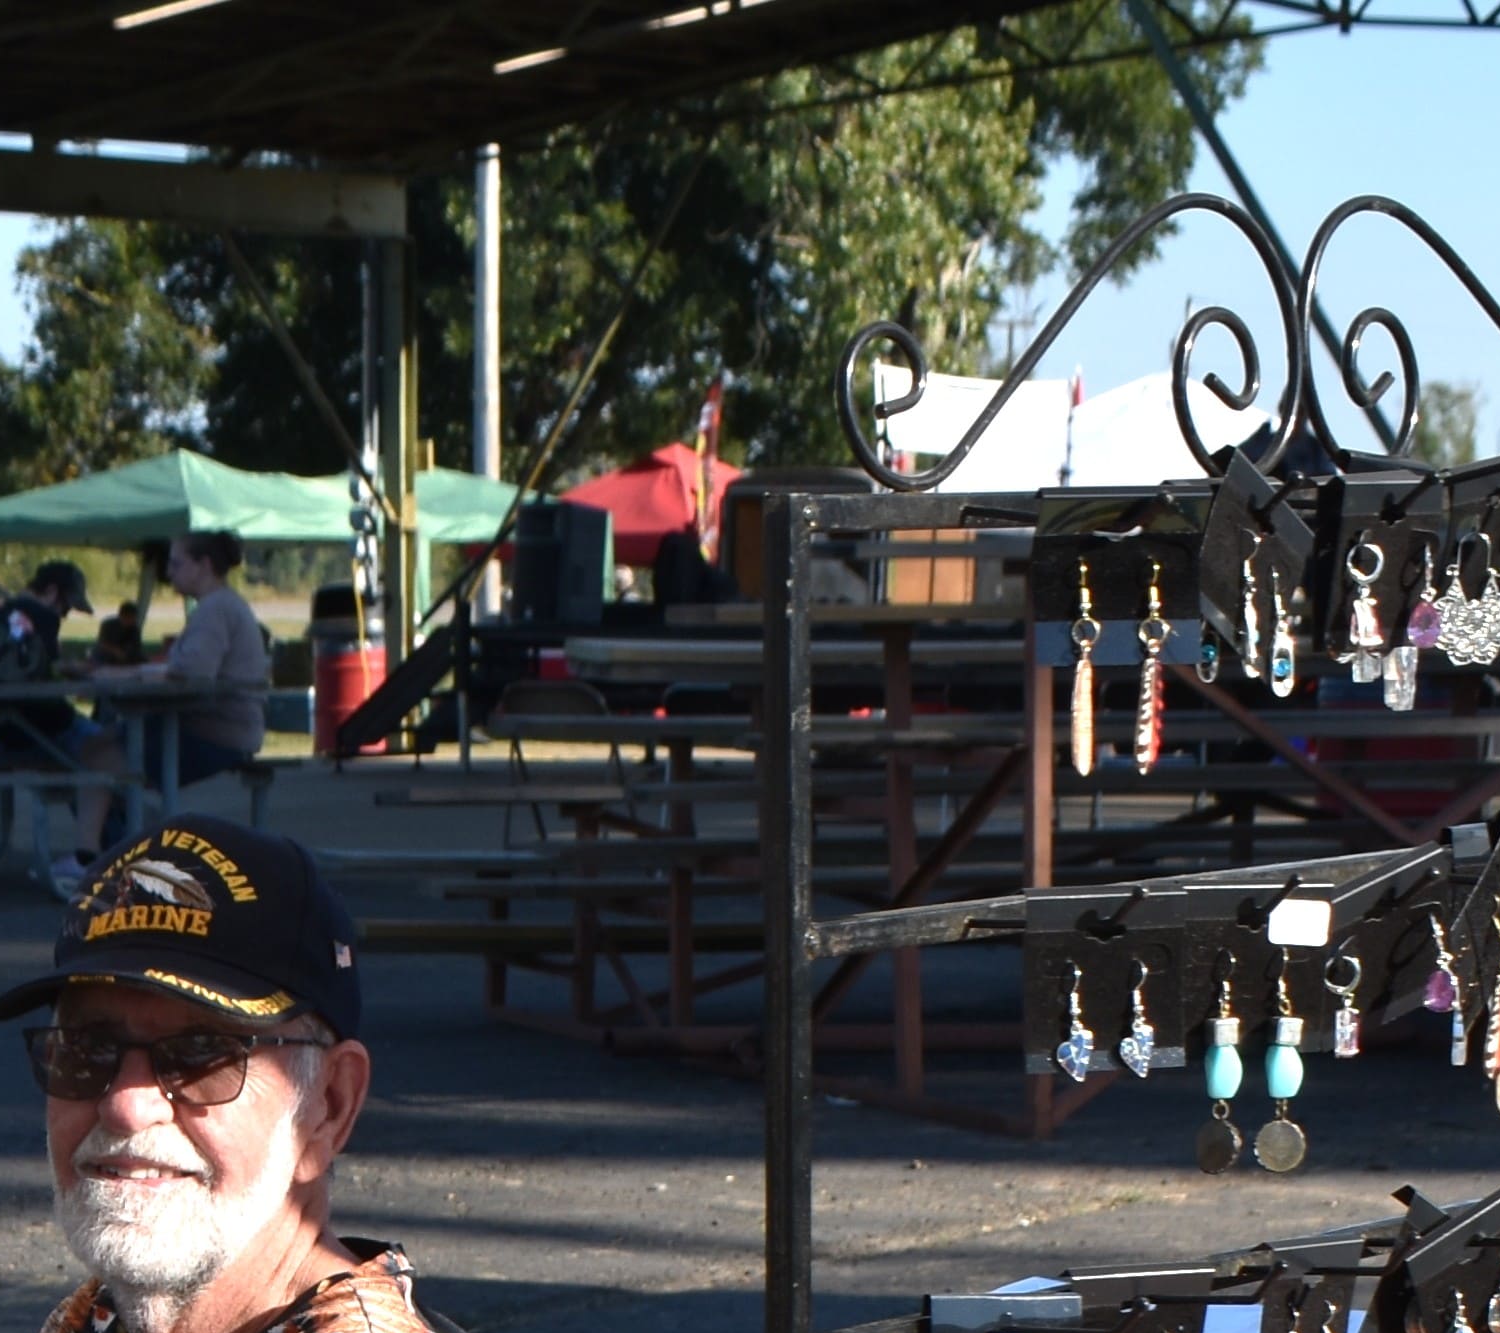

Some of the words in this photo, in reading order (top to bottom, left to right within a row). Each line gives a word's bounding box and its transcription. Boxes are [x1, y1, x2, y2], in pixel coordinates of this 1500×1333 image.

[159, 829, 259, 903] VETERAN
[83, 904, 213, 942] MARINE
[144, 967, 234, 1009] NATIVE
